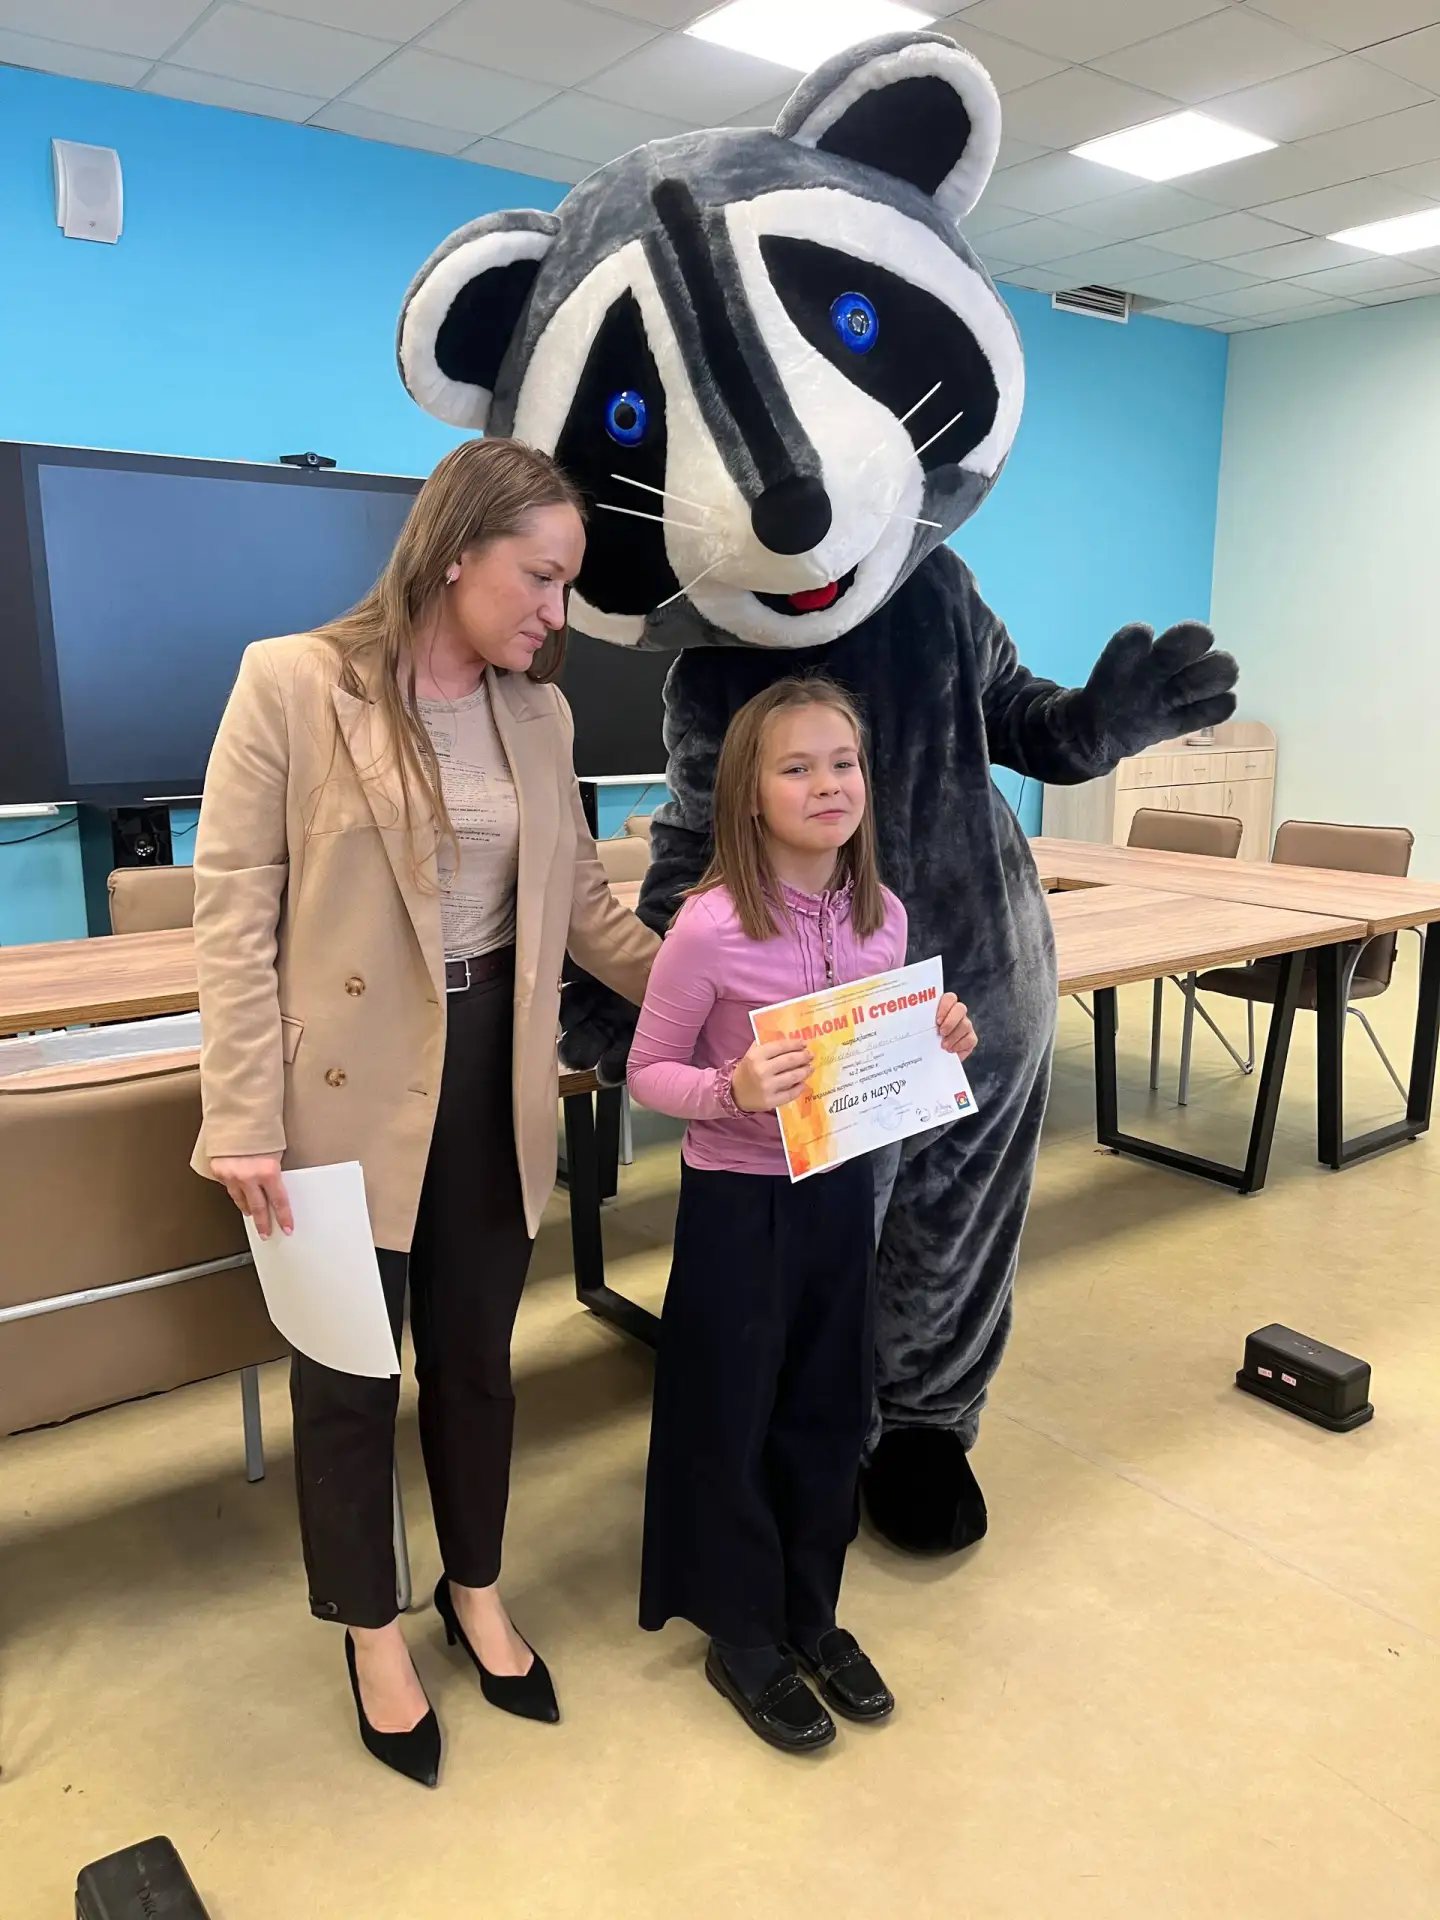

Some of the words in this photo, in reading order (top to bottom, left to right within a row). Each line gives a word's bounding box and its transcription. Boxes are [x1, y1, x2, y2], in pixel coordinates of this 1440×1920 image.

[828, 1094, 860, 1114] «Шаг
[862, 1093, 868, 1103] в
[870, 1079, 907, 1100] науку»
